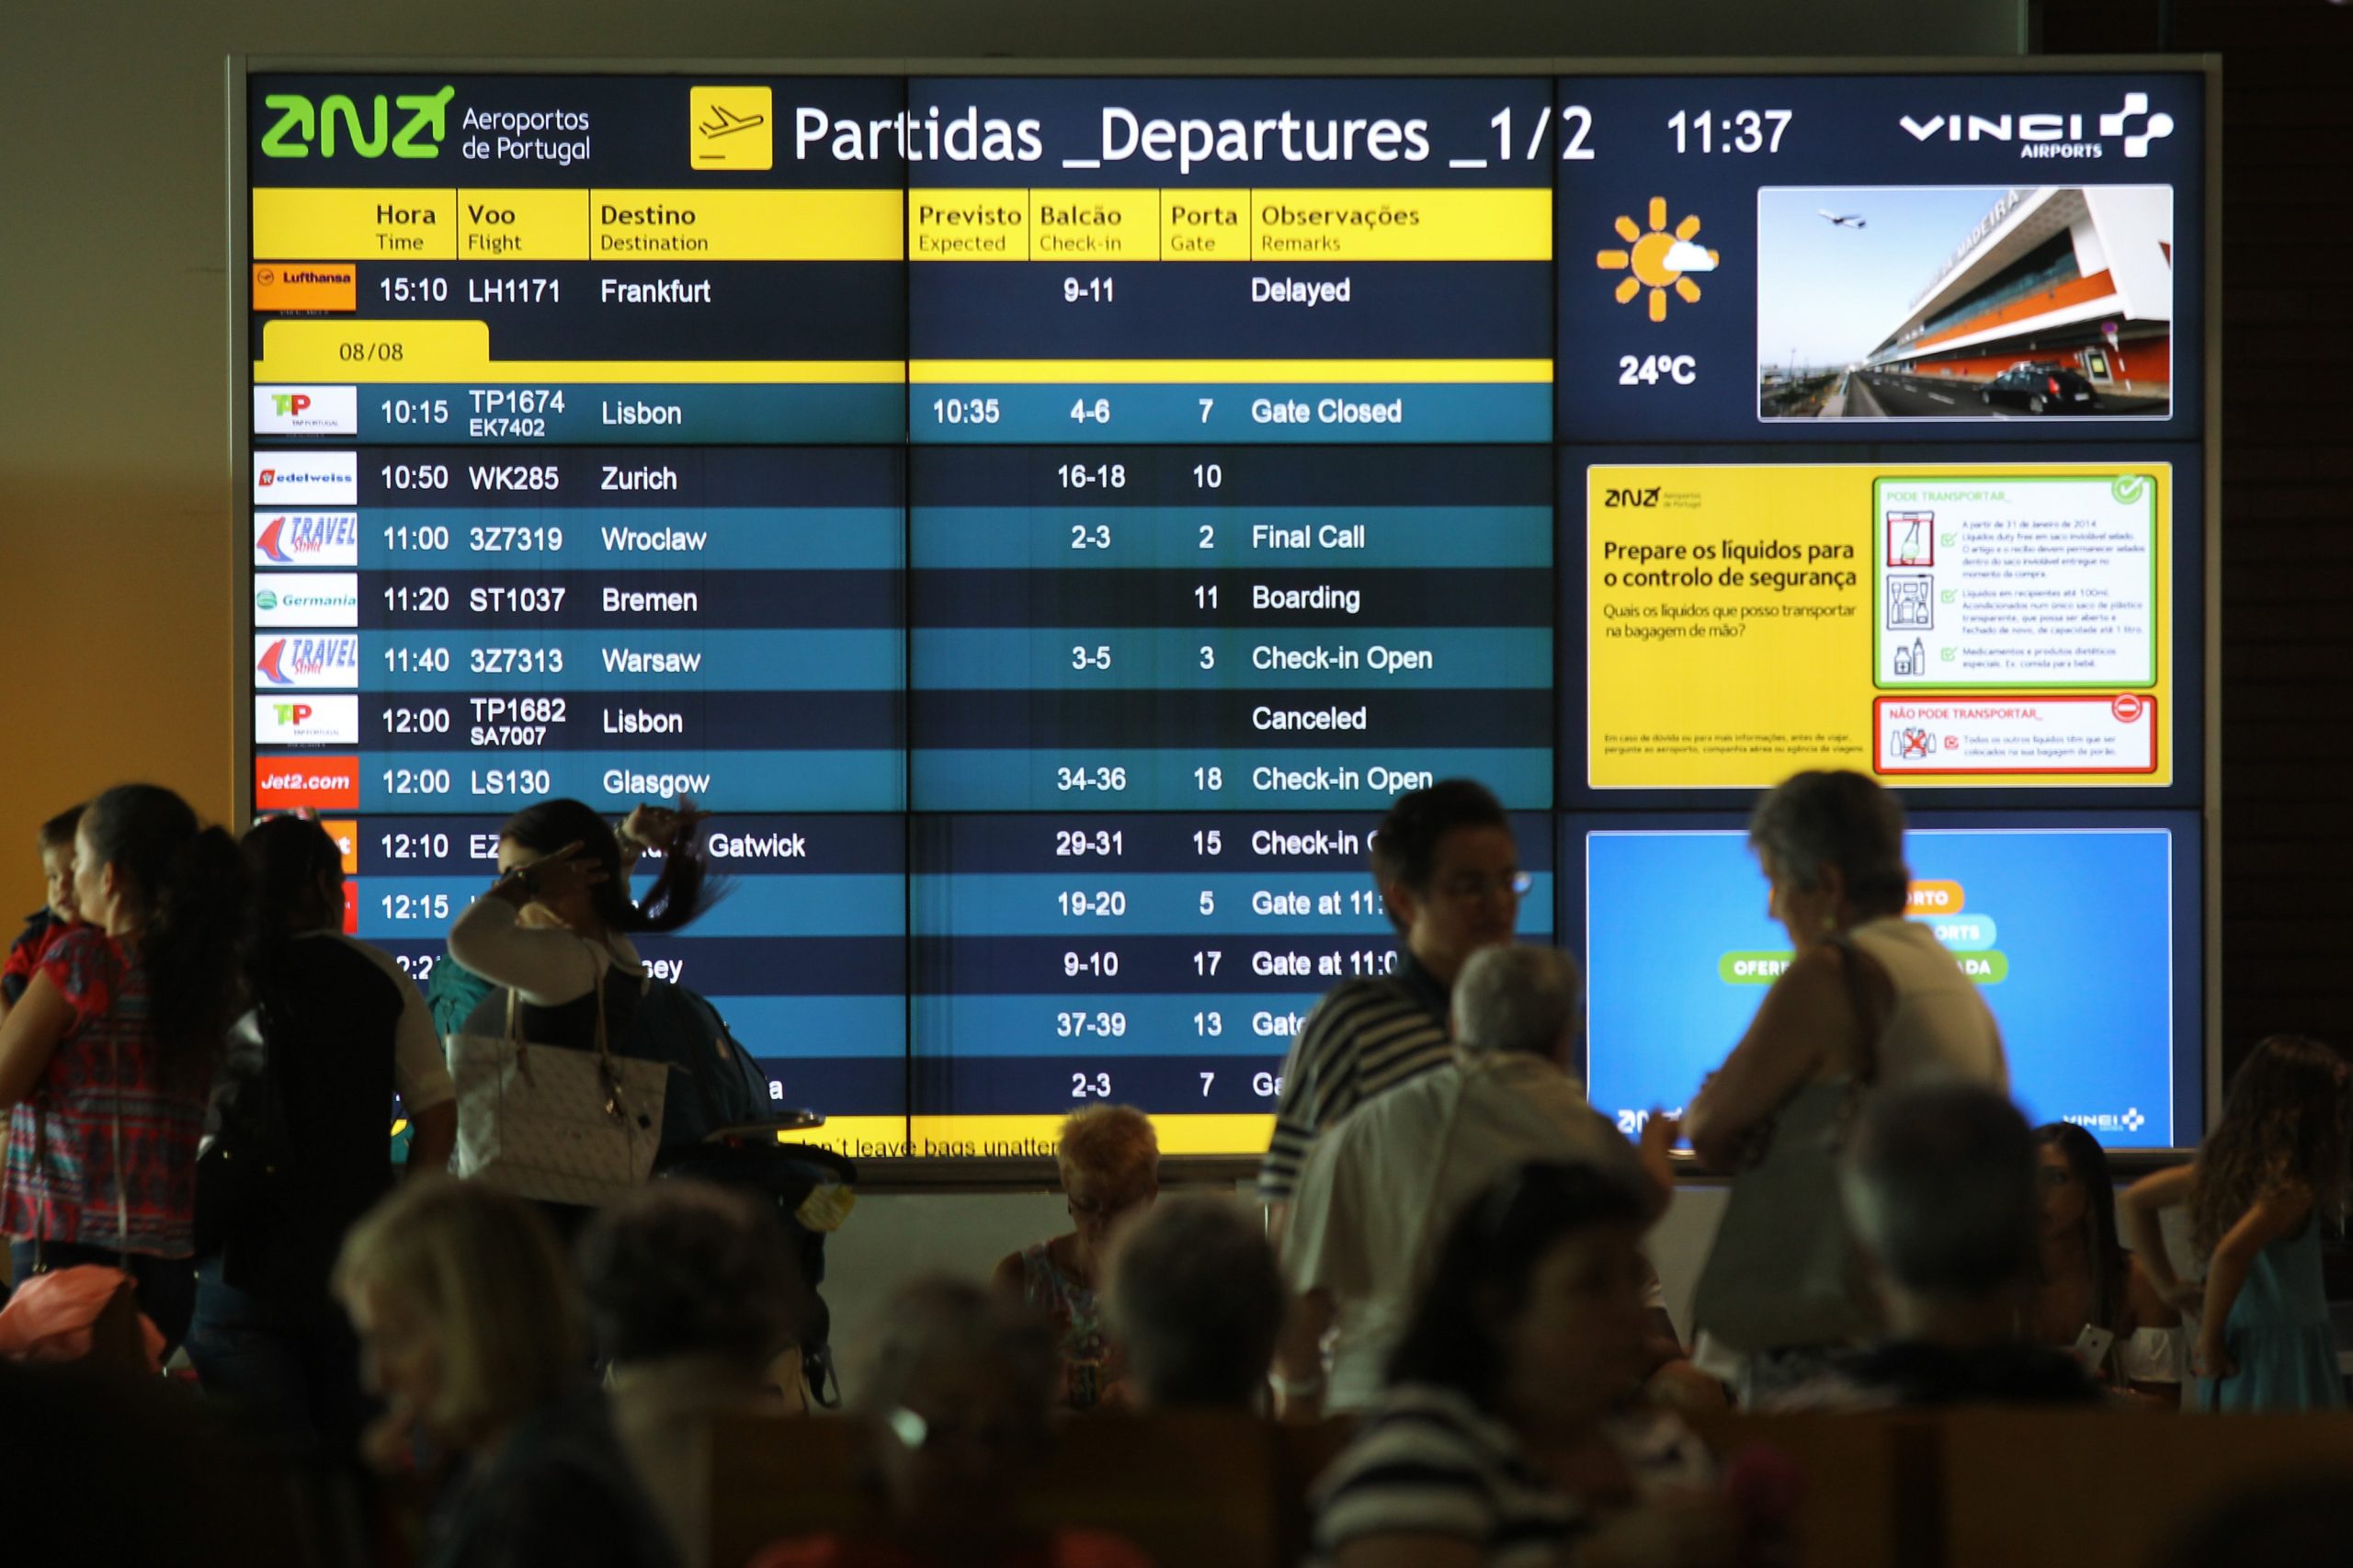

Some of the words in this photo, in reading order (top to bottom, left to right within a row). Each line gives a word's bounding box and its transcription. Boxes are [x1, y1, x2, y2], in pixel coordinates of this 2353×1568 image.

[463, 108, 588, 134] Aeroportos
[1668, 110, 1791, 153] 11:37
[1899, 114, 2083, 142] VINCI
[797, 106, 1042, 161] Partidas
[463, 135, 489, 159] de
[497, 137, 590, 165] Portugal
[2020, 143, 2103, 158] AIRPORTS
[378, 205, 435, 223] Hora
[469, 206, 515, 224] Voo
[602, 205, 695, 224] Destino
[920, 206, 1021, 224] Previsto
[1041, 206, 1121, 224] Balcão
[1173, 207, 1237, 224] Porta
[1262, 206, 1419, 230] Observações
[377, 234, 423, 249] Time
[469, 234, 520, 254] Flight
[602, 235, 708, 250] Destination
[920, 235, 1005, 255] Expected
[1040, 235, 1120, 250] Check-in
[1171, 236, 1215, 251] Gate
[1263, 235, 1340, 251] Remarks
[284, 272, 350, 283] Lufthansa
[381, 278, 447, 301] 15:10
[470, 279, 558, 302] LH1171
[602, 279, 710, 302] Frankfurt
[1064, 278, 1112, 301] 9-11
[1252, 278, 1350, 307] Delayed
[340, 344, 403, 360] 08/08
[272, 395, 311, 415] TAP
[382, 400, 448, 423] 10:15
[469, 391, 564, 413] TP1674
[603, 402, 681, 424] Lisbon
[934, 399, 999, 423] 10:35
[1071, 399, 1109, 423] 4-6
[1199, 399, 1213, 423] 7
[1252, 399, 1310, 423] Gate
[1318, 399, 1402, 423] Closed
[471, 418, 544, 437] EK7402
[277, 472, 352, 483] edelweiss
[382, 466, 448, 488] 10:50
[469, 467, 559, 490] WK285
[601, 467, 676, 489] Zurich
[1059, 465, 1125, 487] 16-18
[1194, 465, 1221, 487] 10
[1887, 492, 1917, 501] PODE
[291, 517, 357, 545] TRAVEL
[384, 527, 449, 550] 11:00
[471, 528, 562, 551] 3Z7319
[602, 528, 707, 551] Wroclaw
[1072, 526, 1110, 548] 2-3
[1199, 525, 1213, 548] 2
[1254, 525, 1310, 548] Final
[1319, 525, 1364, 548] Call
[1605, 542, 1687, 564] Prepare
[1693, 546, 1716, 559] os
[1722, 540, 1802, 564] líquidos
[1809, 545, 1853, 563] para
[1604, 574, 1617, 586] o
[1623, 567, 1712, 586] controlo
[1719, 567, 1744, 585] de
[1750, 572, 1856, 591] segurança
[283, 594, 357, 607] Germania
[385, 587, 449, 610] 11:20
[471, 588, 565, 611] ST1037
[603, 588, 697, 611] Bremen
[1195, 585, 1217, 608] 11
[1254, 585, 1359, 613] Boarding
[1604, 605, 1640, 619] Quais
[1643, 608, 1658, 618] os
[1713, 608, 1737, 621] que
[1741, 608, 1779, 621] posso
[1782, 606, 1856, 621] transportar
[1607, 628, 1621, 637] na
[1625, 624, 1686, 641] bagagem
[1689, 623, 1706, 637] de
[1710, 623, 1745, 637] mão?
[291, 640, 357, 666] TRAVEL
[385, 648, 449, 671] 11:40
[471, 649, 563, 672] 3Z7313
[602, 649, 700, 672] Warsaw
[1073, 646, 1110, 669] 3-5
[1200, 646, 1214, 669] 3
[1253, 646, 1358, 669] Check-in
[1368, 646, 1432, 674] Open
[275, 705, 312, 724] TAP
[383, 709, 449, 733] 12:00
[471, 699, 565, 722] TP1682
[604, 710, 682, 733] Lisbon
[1253, 707, 1366, 729] Canceled
[1890, 708, 1915, 719] NÃO
[1919, 709, 1949, 719] PODE
[471, 726, 546, 745] SA7007
[262, 774, 349, 790] Jet2.com
[383, 769, 449, 793] 12:00
[472, 770, 550, 794] LS130
[604, 770, 710, 796] Glasgow
[1058, 767, 1126, 790] 34-36
[1195, 767, 1222, 790] 18
[1253, 767, 1358, 790] Check-in
[1368, 767, 1433, 794] Open
[382, 834, 448, 858] 12:10
[709, 834, 805, 857] Gatwick
[1057, 831, 1121, 855] 29-31
[1194, 831, 1221, 855] 15
[1252, 830, 1358, 855] Check-in
[382, 894, 449, 918] 12:15
[1059, 892, 1125, 915] 19-20
[1200, 892, 1213, 915] 5
[1253, 891, 1311, 915] Gate
[1318, 892, 1341, 915] at
[1351, 892, 1382, 915] 11:
[642, 960, 682, 983] sey
[1064, 952, 1118, 976] 9-10
[1194, 951, 1221, 975] 17
[1252, 951, 1311, 975] Gate
[1319, 951, 1341, 975] at
[1351, 951, 1397, 975] 11:0
[1057, 1013, 1126, 1036] 37-39
[1194, 1012, 1222, 1036] 13
[1073, 1073, 1110, 1096] 2-3
[1200, 1073, 1214, 1096] 7
[857, 1138, 916, 1157] leave
[984, 1137, 1055, 1156] unatte
